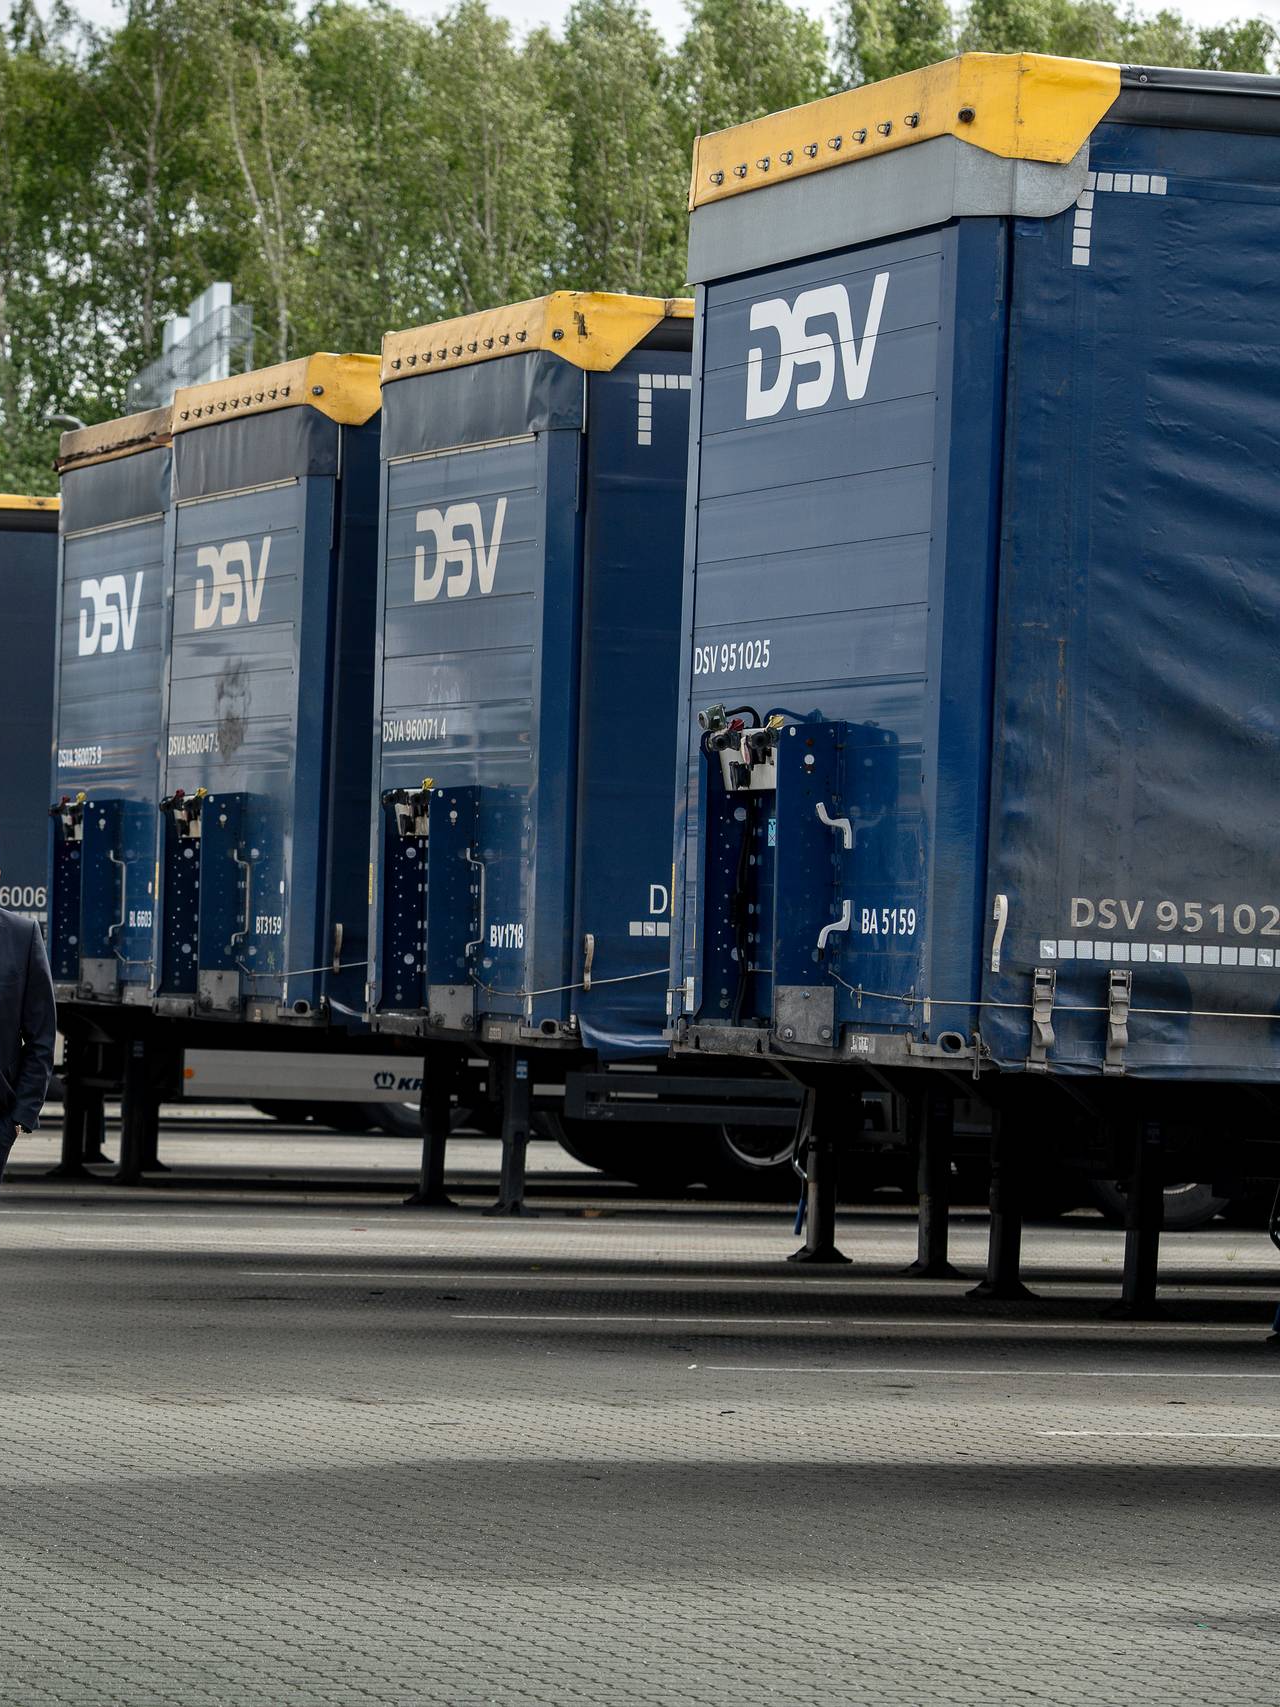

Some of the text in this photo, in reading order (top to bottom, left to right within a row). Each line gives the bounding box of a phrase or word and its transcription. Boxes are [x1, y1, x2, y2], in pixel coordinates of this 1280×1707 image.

[746, 272, 889, 420] DSV
[414, 497, 507, 602] DSV
[195, 536, 271, 629] DSV
[78, 571, 143, 656] DSV
[694, 639, 771, 675] DSV 951025
[167, 735, 186, 757] DSVA
[382, 717, 447, 742] DSVA 960071 4
[861, 908, 917, 936] BA 5159
[1071, 897, 1280, 936] DSV 95102
